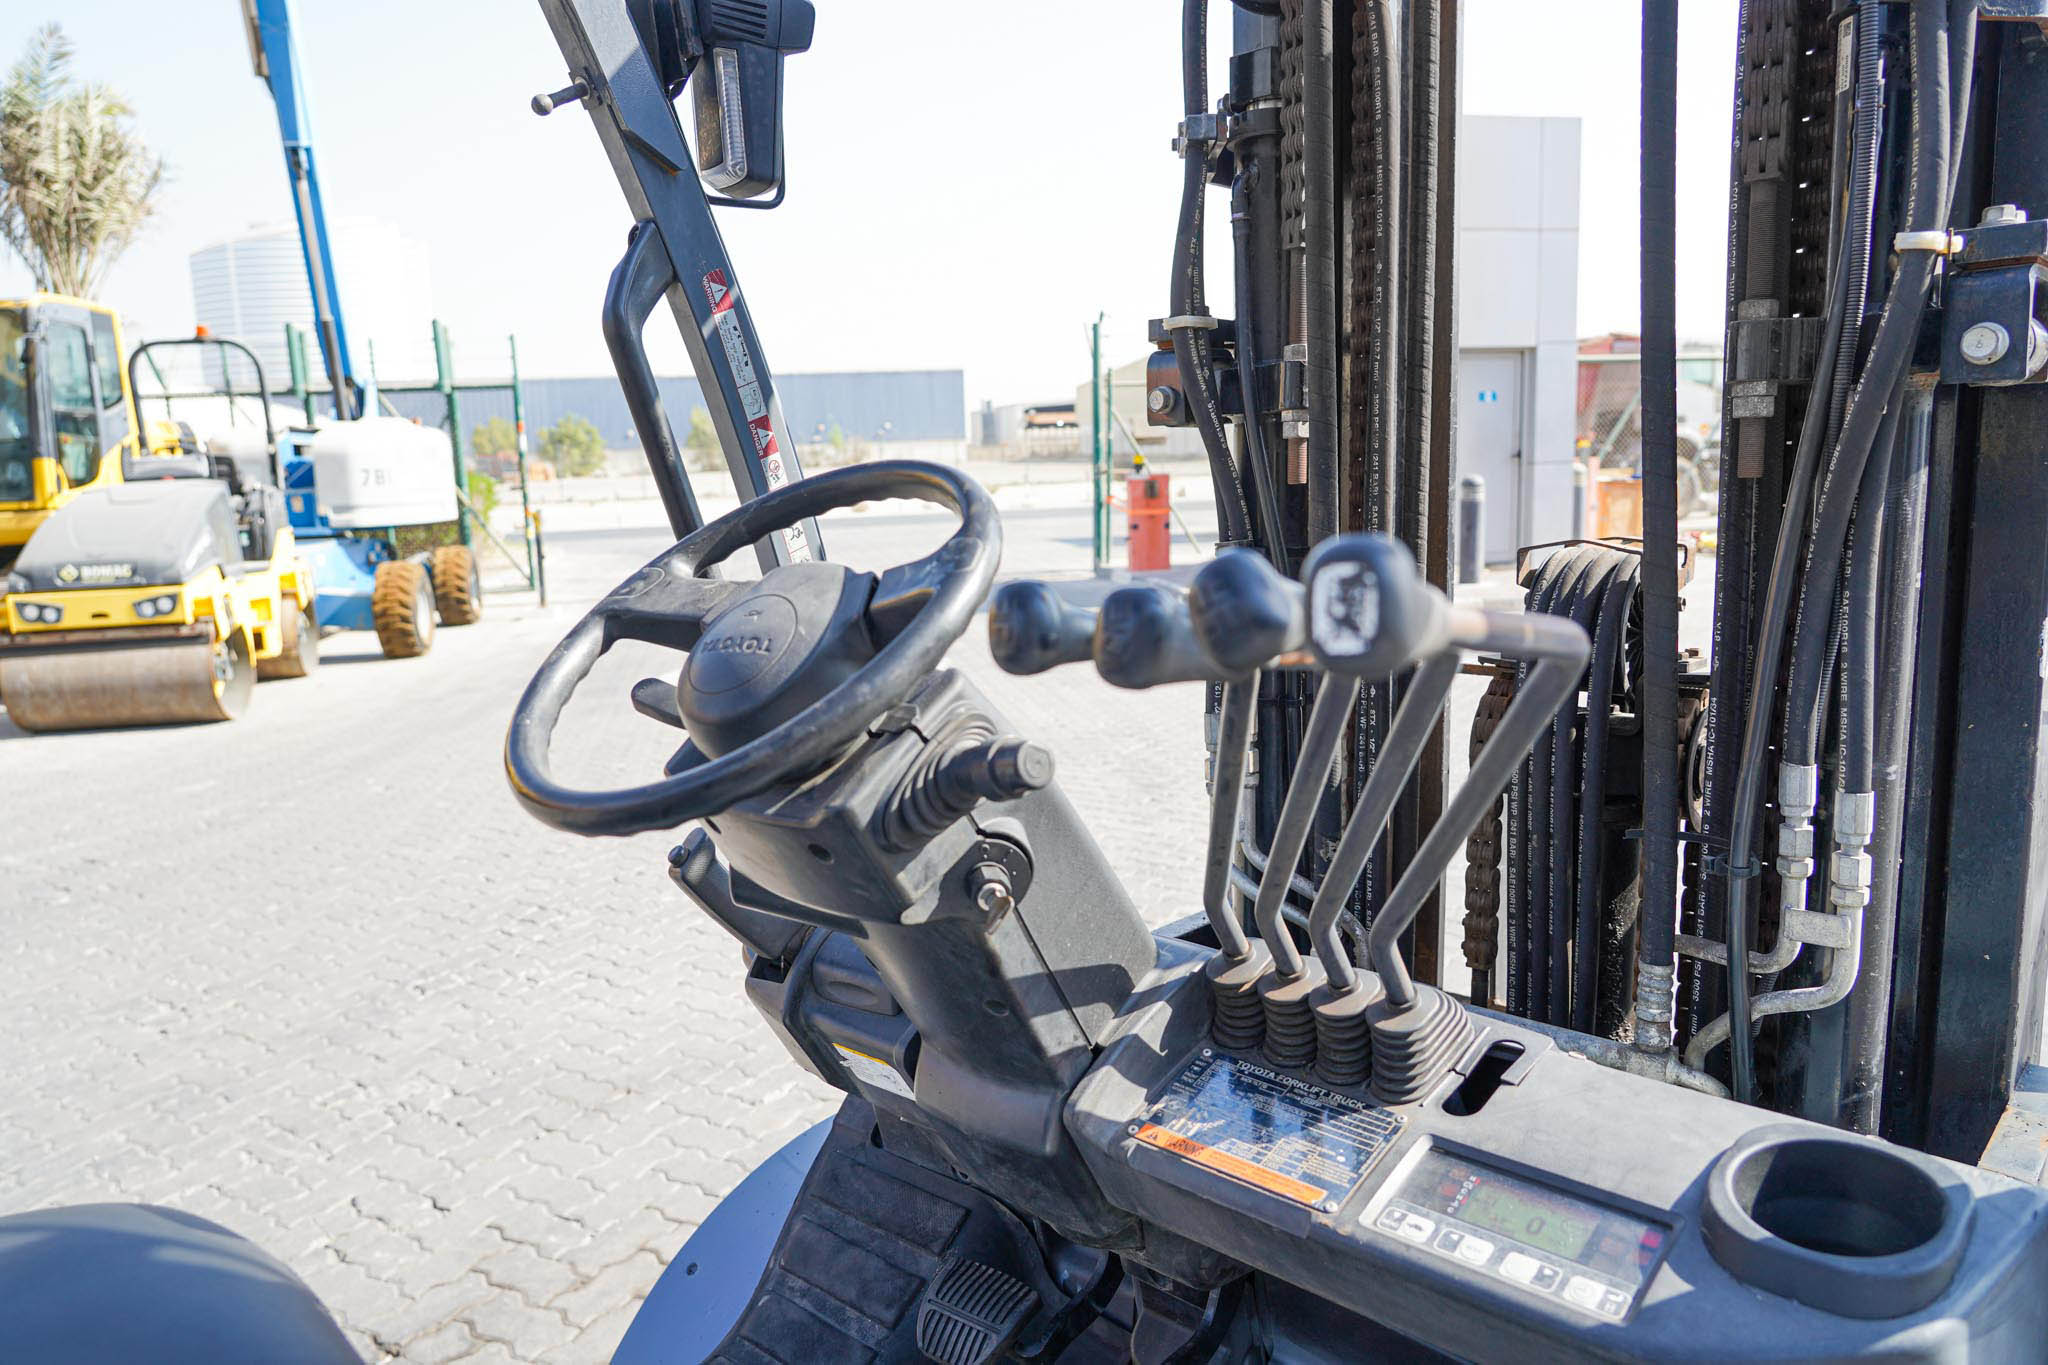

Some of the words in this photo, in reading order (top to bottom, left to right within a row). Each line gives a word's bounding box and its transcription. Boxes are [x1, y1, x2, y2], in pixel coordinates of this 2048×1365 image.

[1371, 32, 1379, 57] BAR)
[1374, 66, 1382, 120] SAE100R16
[703, 275, 718, 313] WARNING
[749, 424, 764, 457] DANGER
[1841, 590, 1850, 653] SAE100R16
[700, 638, 772, 656] TOYOTA
[1708, 696, 1717, 743] IC-101/34
[1840, 707, 1848, 740] MSHA
[1705, 745, 1715, 775] MSHA
[1510, 785, 1519, 800] PSI
[1704, 780, 1712, 807] WIRE
[1510, 801, 1518, 816] WP
[1703, 809, 1711, 817] 2
[1509, 837, 1517, 859] BAR)
[1509, 866, 1517, 913] SAE100R16
[1508, 950, 1516, 975] MSHA
[1694, 960, 1702, 978] PSI
[1692, 979, 1701, 1001] 3500
[1236, 1060, 1276, 1082] TOYOTA
[1277, 1073, 1328, 1100] FORKLIFT
[1328, 1091, 1368, 1112] TRUCK
